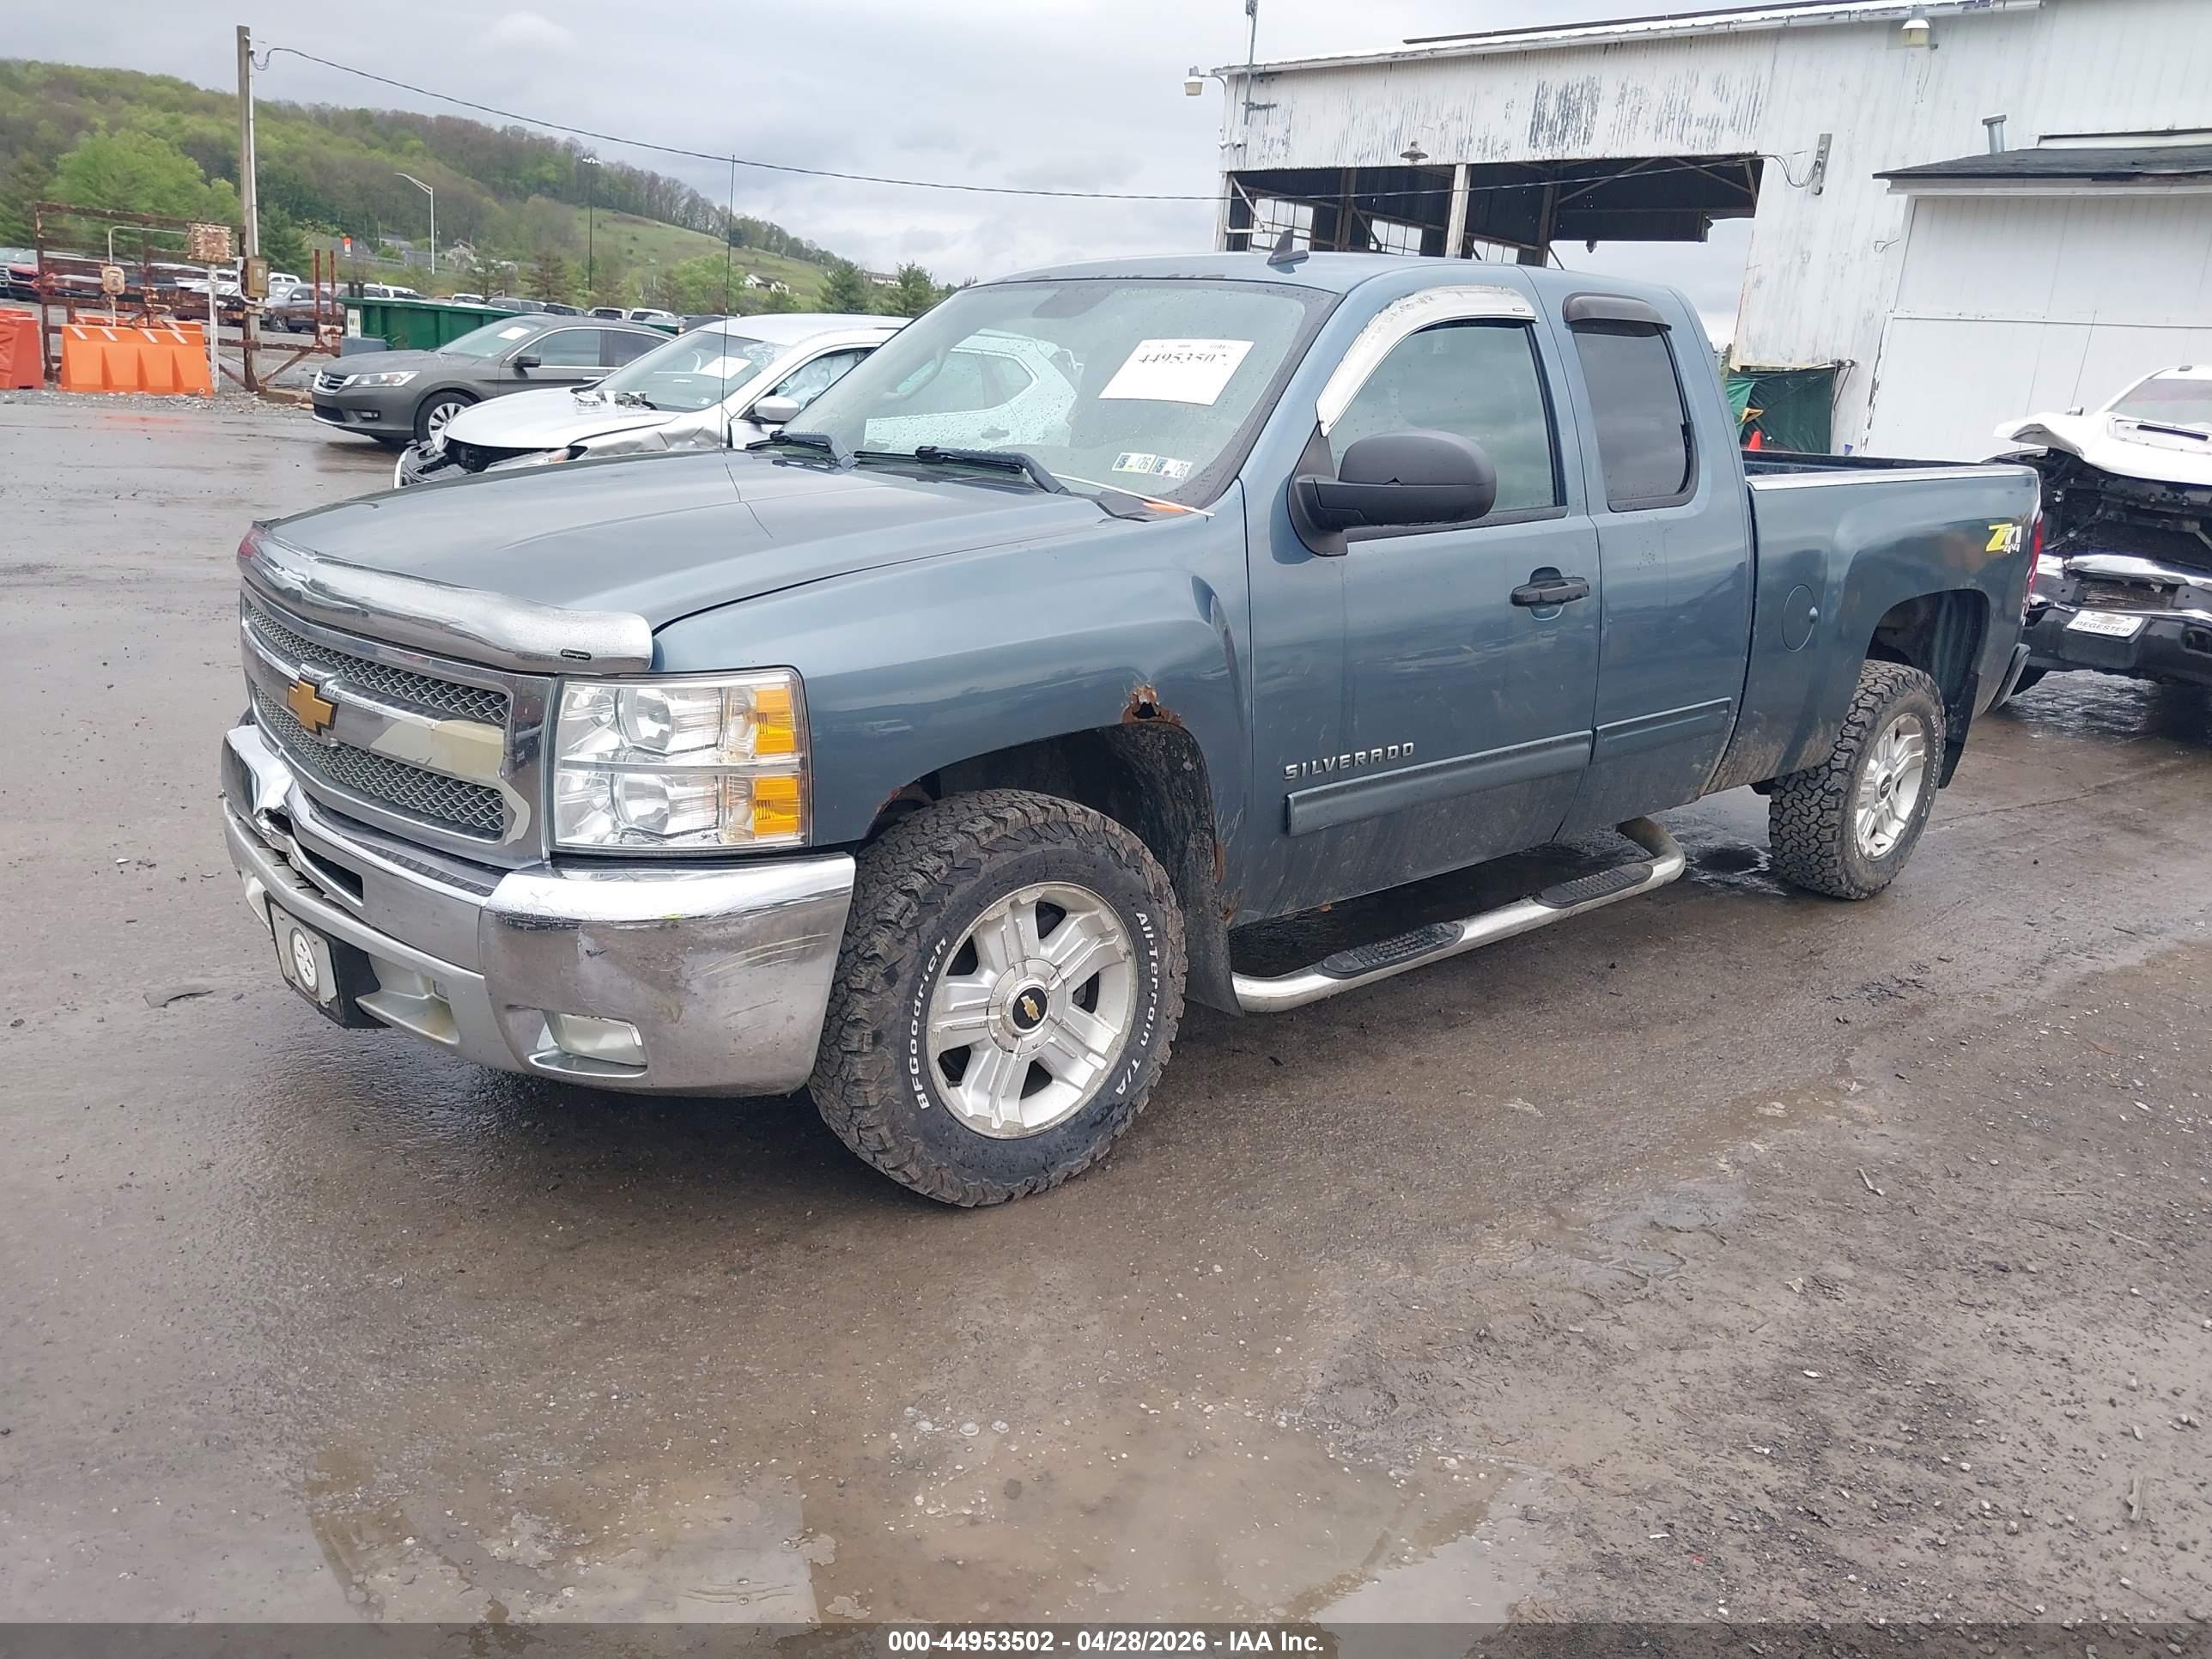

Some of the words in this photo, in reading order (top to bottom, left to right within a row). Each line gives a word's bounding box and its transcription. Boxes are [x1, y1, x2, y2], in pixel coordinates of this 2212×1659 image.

[1985, 523, 2022, 552] Z71
[1283, 742, 1415, 781] SILVERADO
[1135, 912, 1159, 1047] All-Terrain
[908, 937, 947, 1109] BFGoodrich
[1115, 1058, 1141, 1095] T/A
